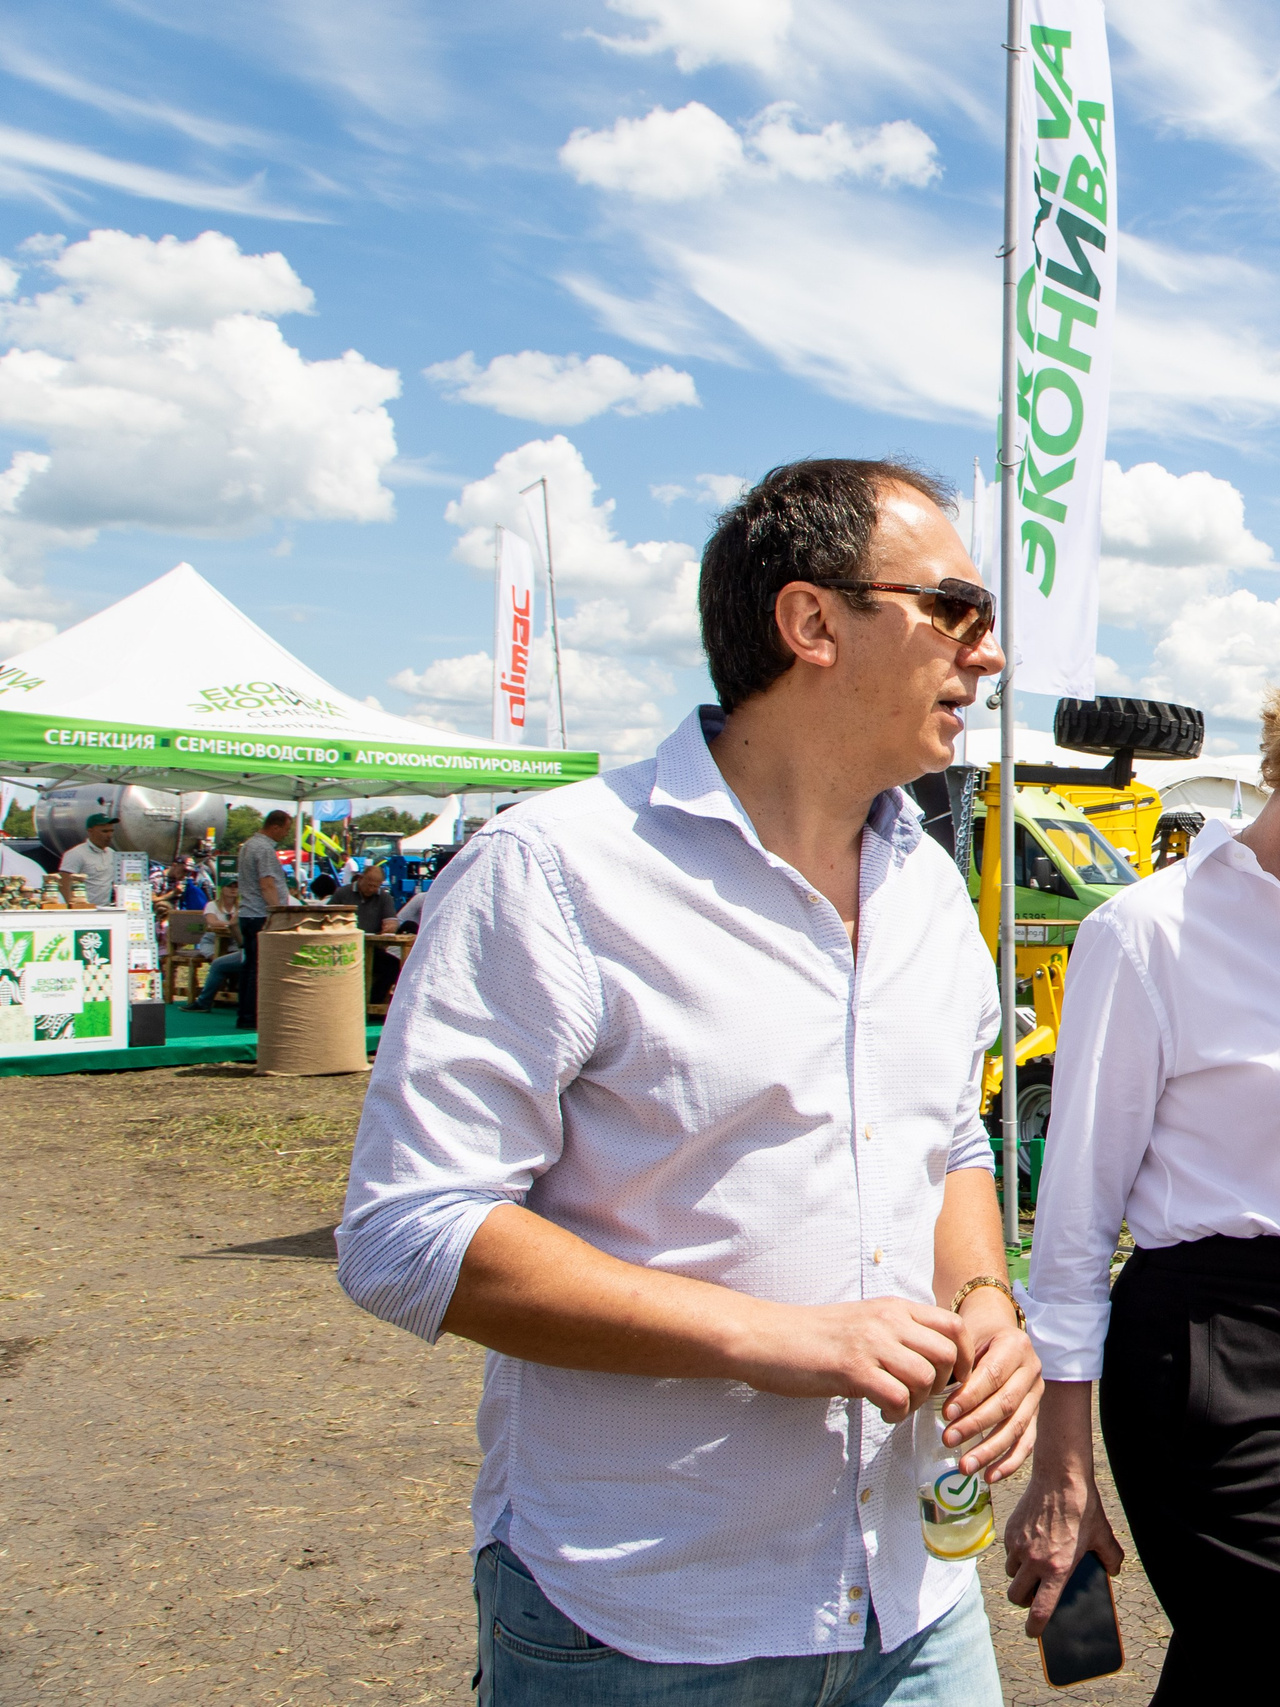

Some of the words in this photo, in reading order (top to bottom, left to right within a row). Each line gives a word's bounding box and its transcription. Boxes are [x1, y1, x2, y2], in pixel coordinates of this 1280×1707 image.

[1021, 99, 1107, 598] ЭКОНИВА
[44, 729, 155, 750] СЕЛЕКЦИЯ
[174, 736, 340, 764] СЕМЕНОВОДСТВО
[355, 750, 562, 775] АГРОКОНСУЛЬТИРОВАНИЕ
